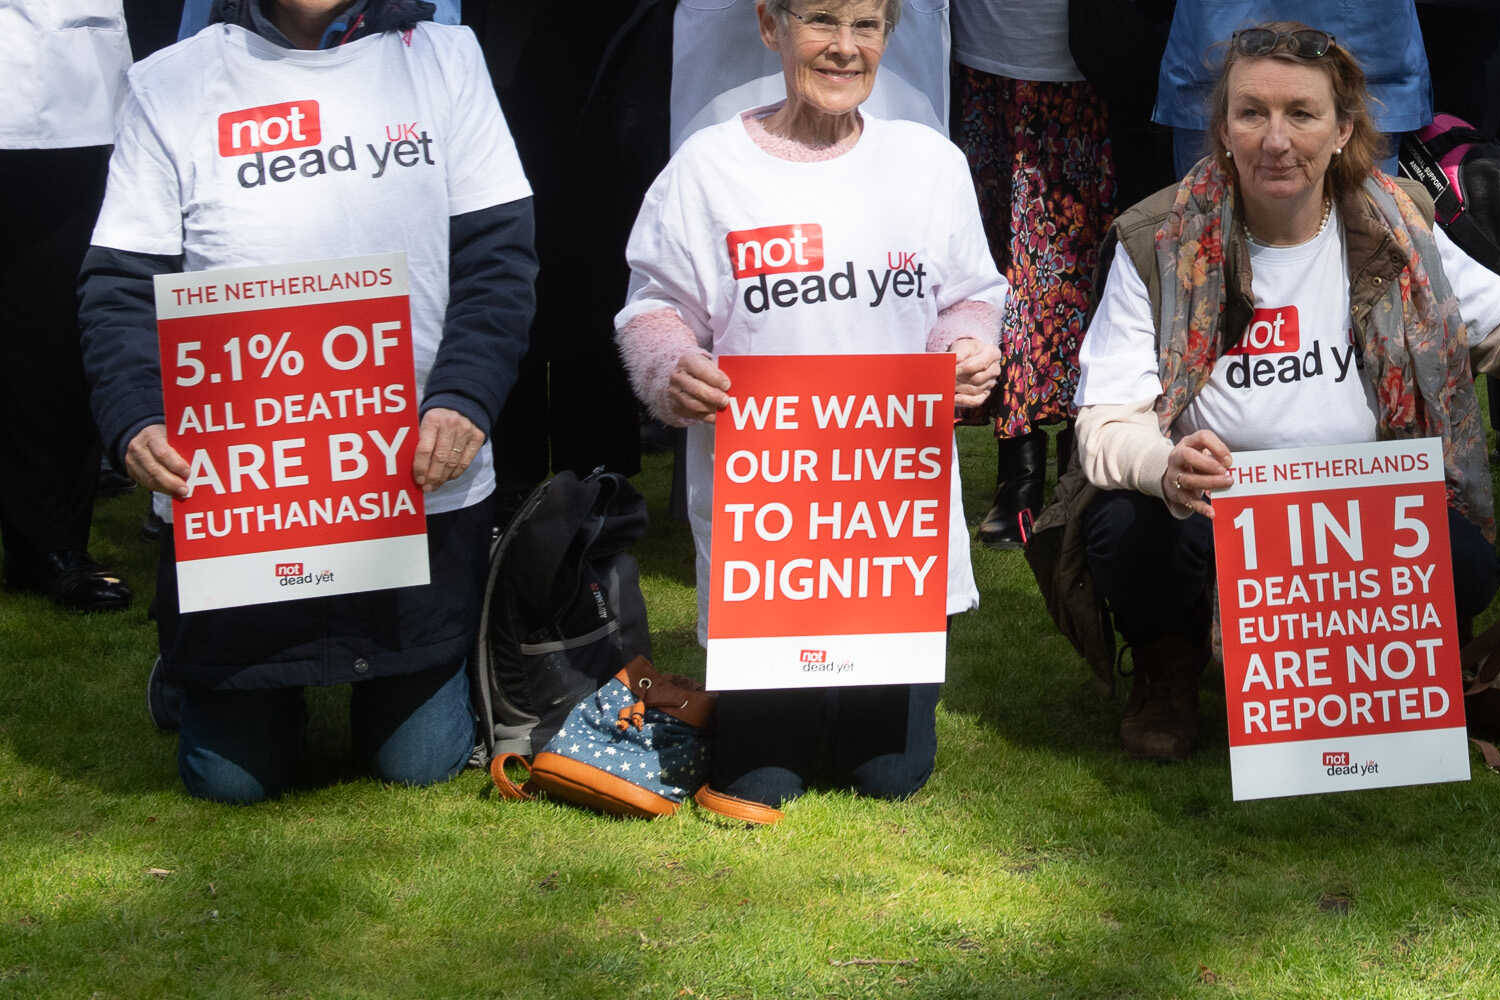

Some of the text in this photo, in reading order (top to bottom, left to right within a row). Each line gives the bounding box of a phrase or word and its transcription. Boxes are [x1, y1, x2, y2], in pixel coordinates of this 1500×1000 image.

[231, 106, 308, 149] not
[385, 122, 419, 143] UK
[237, 131, 435, 189] dead yet
[737, 234, 808, 270] not
[887, 251, 915, 270] UK
[172, 268, 393, 306] THE NETHERLANDS
[744, 262, 927, 313] dead yet
[175, 320, 401, 388] 5.1% OF
[177, 383, 407, 437] ALL DEATHS
[730, 394, 943, 430] WE WANT
[186, 426, 411, 498] ARE BY
[724, 447, 942, 484] OUR LIVES
[1228, 453, 1429, 484] THE NETHERLANDS
[184, 489, 417, 540] EUTHANASIA
[724, 500, 939, 542] TO HAVE
[1233, 495, 1431, 570] 1 IN 5
[278, 564, 302, 576] not
[279, 570, 334, 587] dead yet
[722, 555, 938, 602] DIGNITY
[1237, 564, 1436, 608] DEATHS BY
[1239, 603, 1442, 644] EUTHANASIA
[1242, 638, 1444, 693] ARE NOT
[1243, 686, 1450, 735] REPORTED
[1325, 754, 1346, 764] not
[1326, 761, 1379, 776] dead yet
